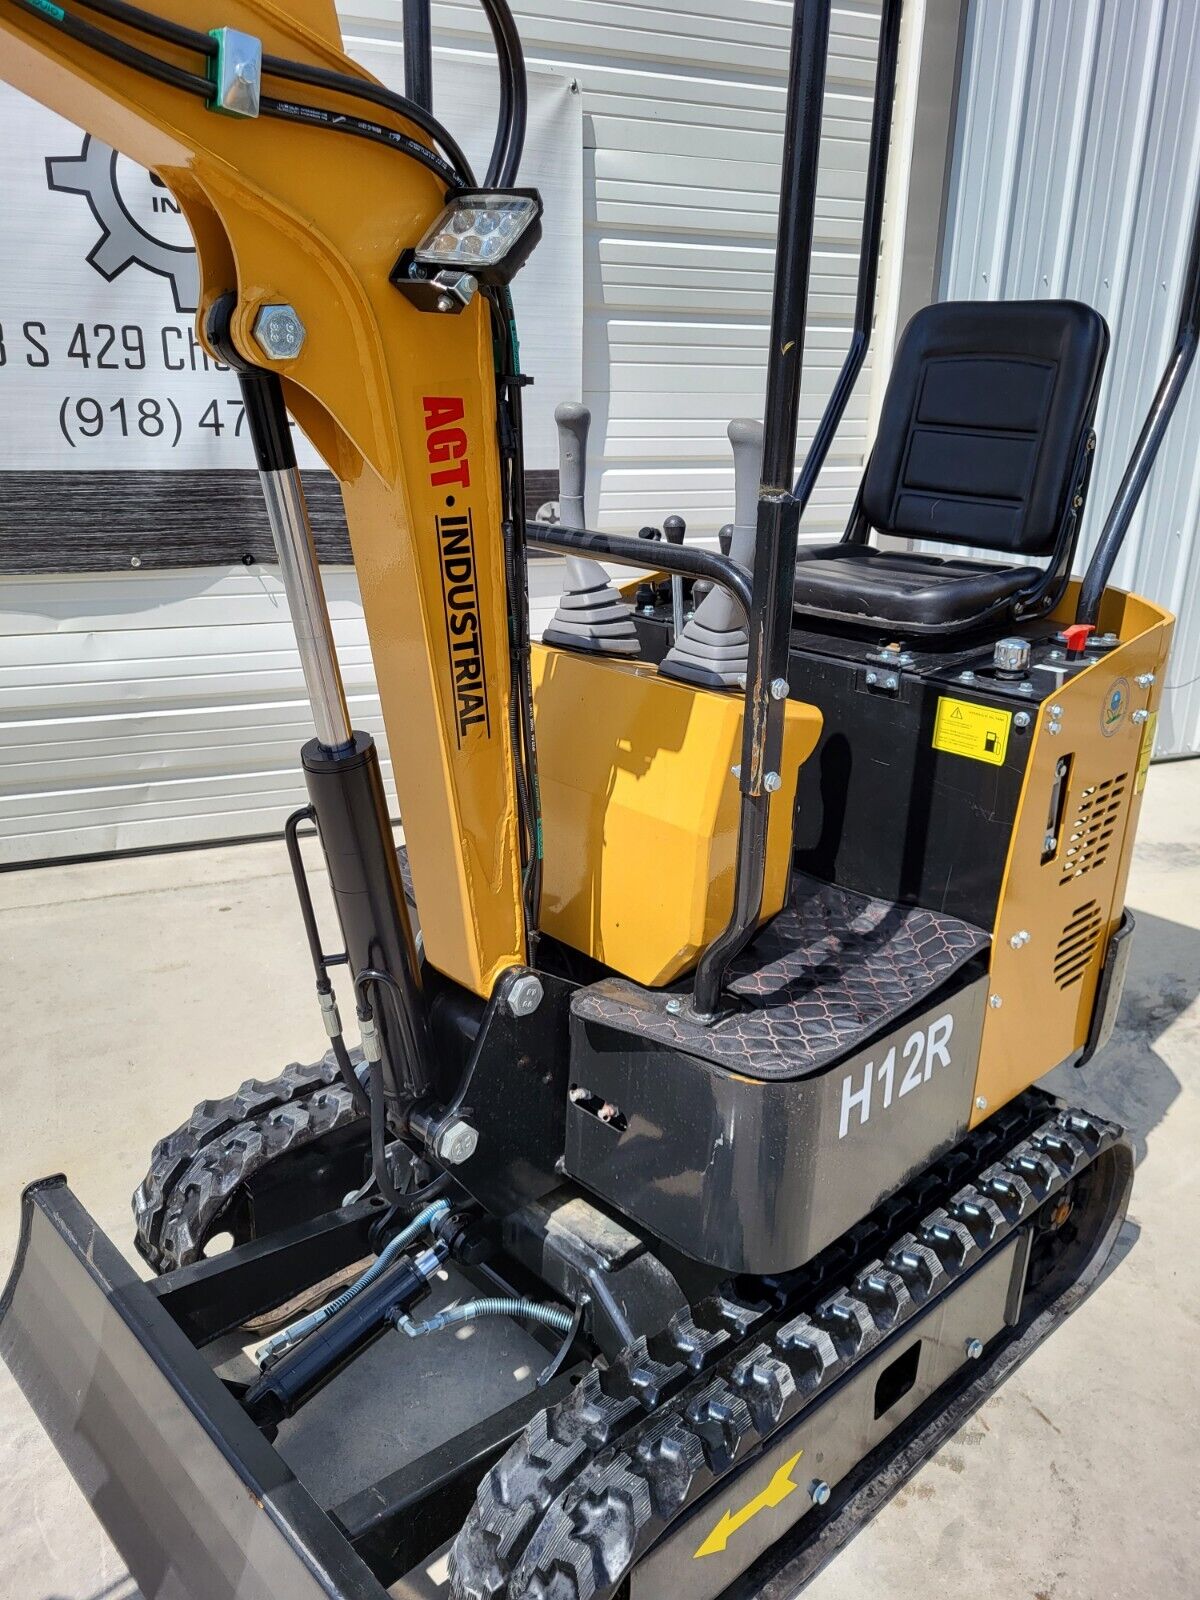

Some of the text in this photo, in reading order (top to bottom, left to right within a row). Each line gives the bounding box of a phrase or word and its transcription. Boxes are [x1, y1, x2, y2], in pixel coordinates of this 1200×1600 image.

[22, 321, 50, 368] S
[67, 323, 146, 369] 429
[59, 396, 183, 448] (918)
[422, 395, 487, 738] AGT INDUSTRIAL
[838, 1013, 954, 1141] H12R
